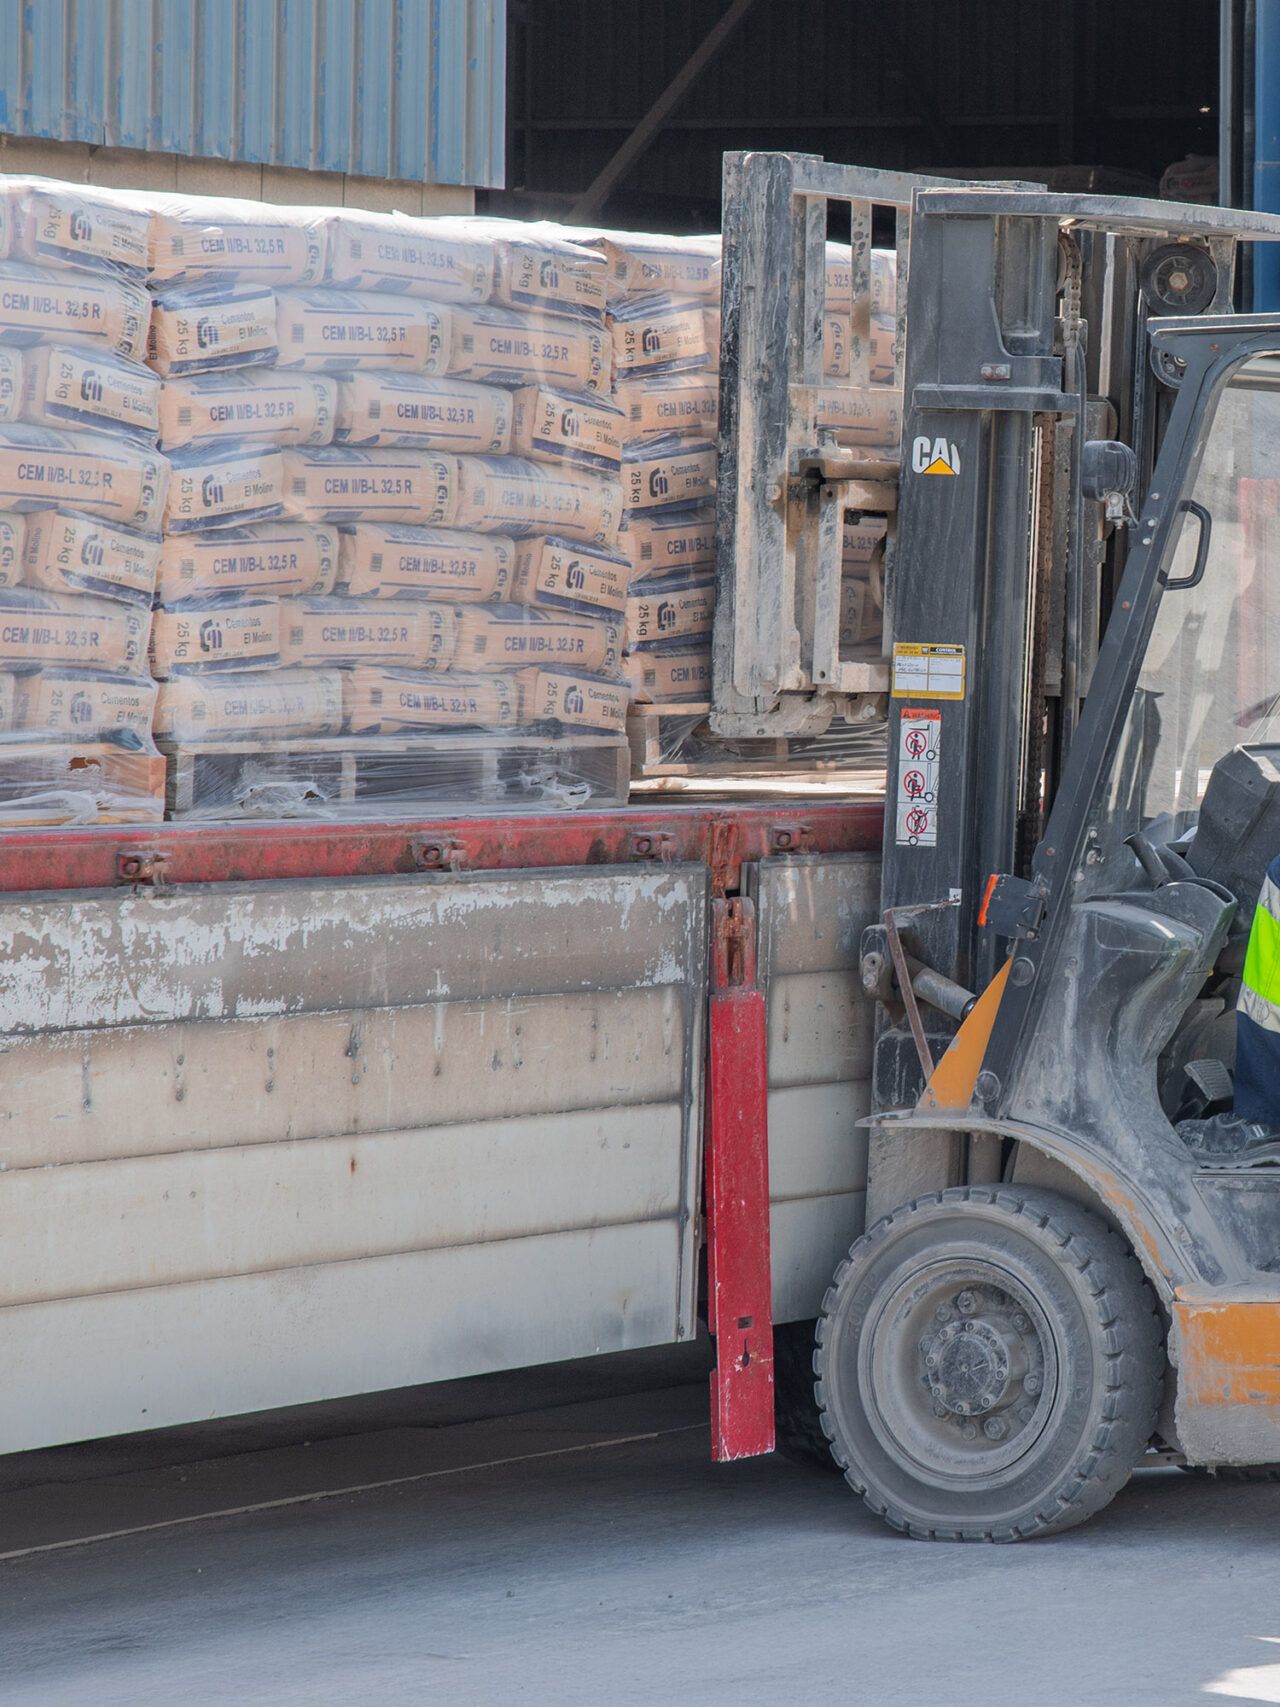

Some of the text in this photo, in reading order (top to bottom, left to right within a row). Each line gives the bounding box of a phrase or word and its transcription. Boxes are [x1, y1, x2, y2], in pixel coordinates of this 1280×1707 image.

[43, 223, 60, 239] kg
[201, 238, 284, 254] CEM II/B-L 32,5 R
[519, 256, 533, 288] 25 kg
[2, 293, 100, 320] CEM II/B-L 32,5 R
[176, 319, 189, 355] 25 kg
[239, 328, 246, 340] El
[322, 325, 406, 343] CEM II/B-L 32,5 R
[625, 331, 635, 346] 25
[490, 338, 568, 361] CEM II/B-L 32,5 R
[56, 362, 73, 400] 25 kg
[122, 397, 130, 408] El
[656, 403, 677, 417] CEM
[210, 402, 295, 422] CEM II/B-L 32,5 R
[397, 403, 474, 424] CEM II/B-L 32,5 R
[541, 402, 555, 435] 25 kg
[596, 432, 603, 442] El
[17, 463, 113, 488] CEM II/B-L R
[685, 478, 692, 488] El
[179, 477, 193, 513] 25 kg
[244, 485, 250, 497] El
[324, 478, 412, 496] CEM II/B-L 32,5 R
[629, 471, 642, 503] 25 kg
[57, 527, 76, 564] 25 kg
[667, 541, 687, 555] CEM
[125, 560, 132, 572] El
[213, 554, 297, 574] CEM II/B-L 32,5 R
[400, 556, 476, 577] CEM II/B-L 32,5 R
[544, 555, 562, 588] 25 kg
[600, 583, 606, 593] El
[636, 605, 650, 636] 25 kg
[2, 627, 99, 648] CEM II/B-L 32,5 R
[174, 621, 190, 657] 25 kg
[244, 633, 250, 644] El
[322, 627, 408, 642] CEM II/B-L 32,5 R
[504, 637, 584, 653] CEM II/B-L 32,5 R
[671, 669, 689, 682] CEM
[400, 692, 421, 708] CEM
[543, 682, 558, 715] 25 kg
[117, 711, 125, 722] El
[602, 705, 609, 716] El
